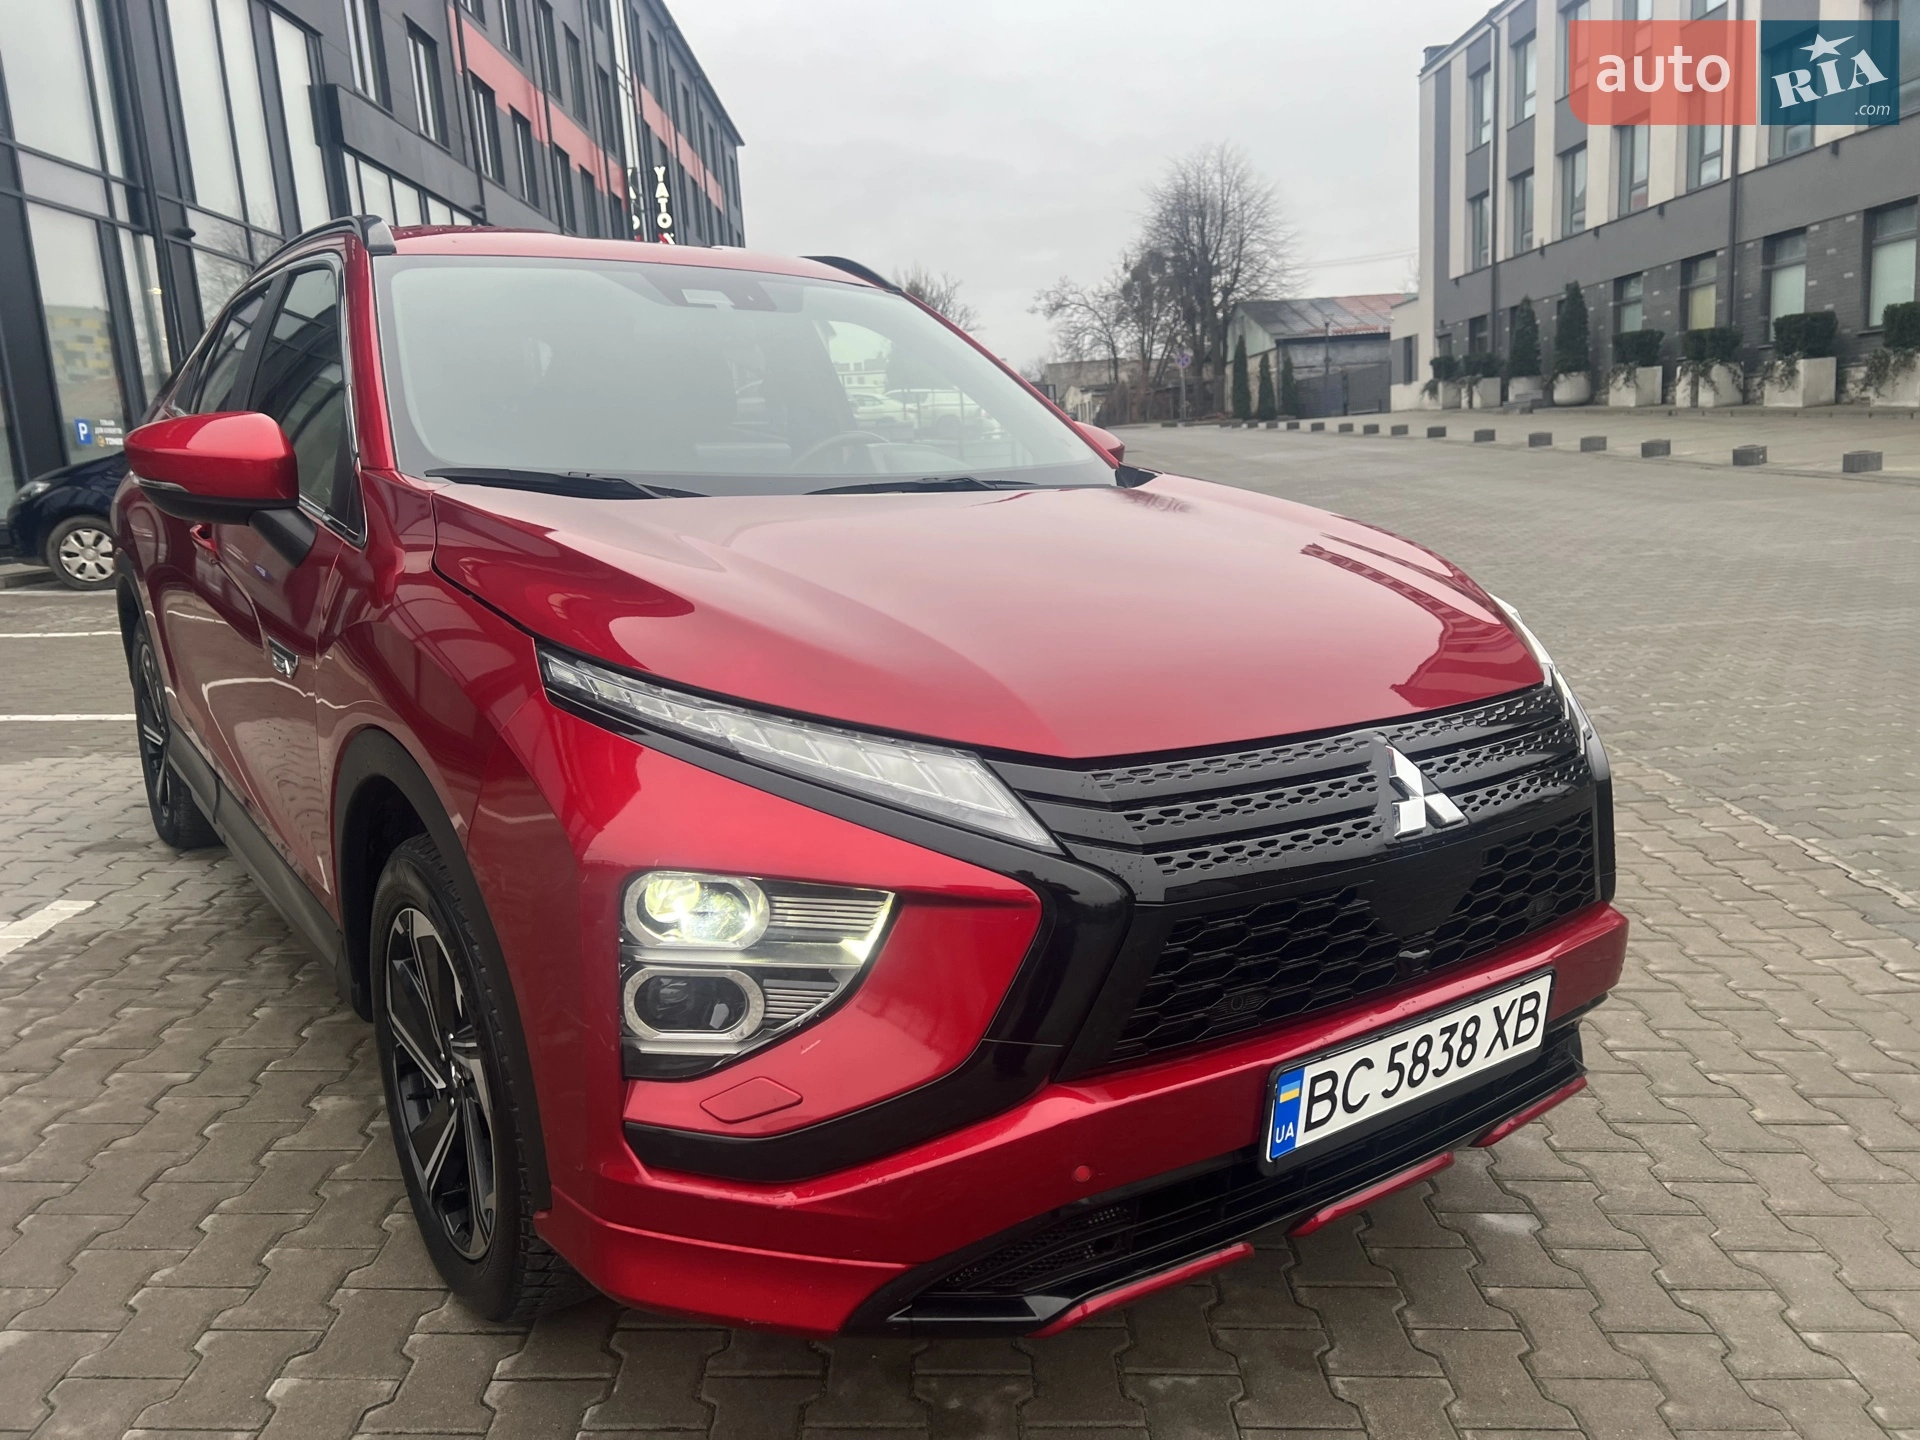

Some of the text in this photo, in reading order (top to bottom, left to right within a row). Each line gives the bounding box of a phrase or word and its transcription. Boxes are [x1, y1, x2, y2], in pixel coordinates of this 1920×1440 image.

[654, 166, 672, 229] YATO
[78, 422, 88, 440] P
[1304, 991, 1541, 1133] BC 5838 XB
[1276, 1122, 1295, 1144] UA
